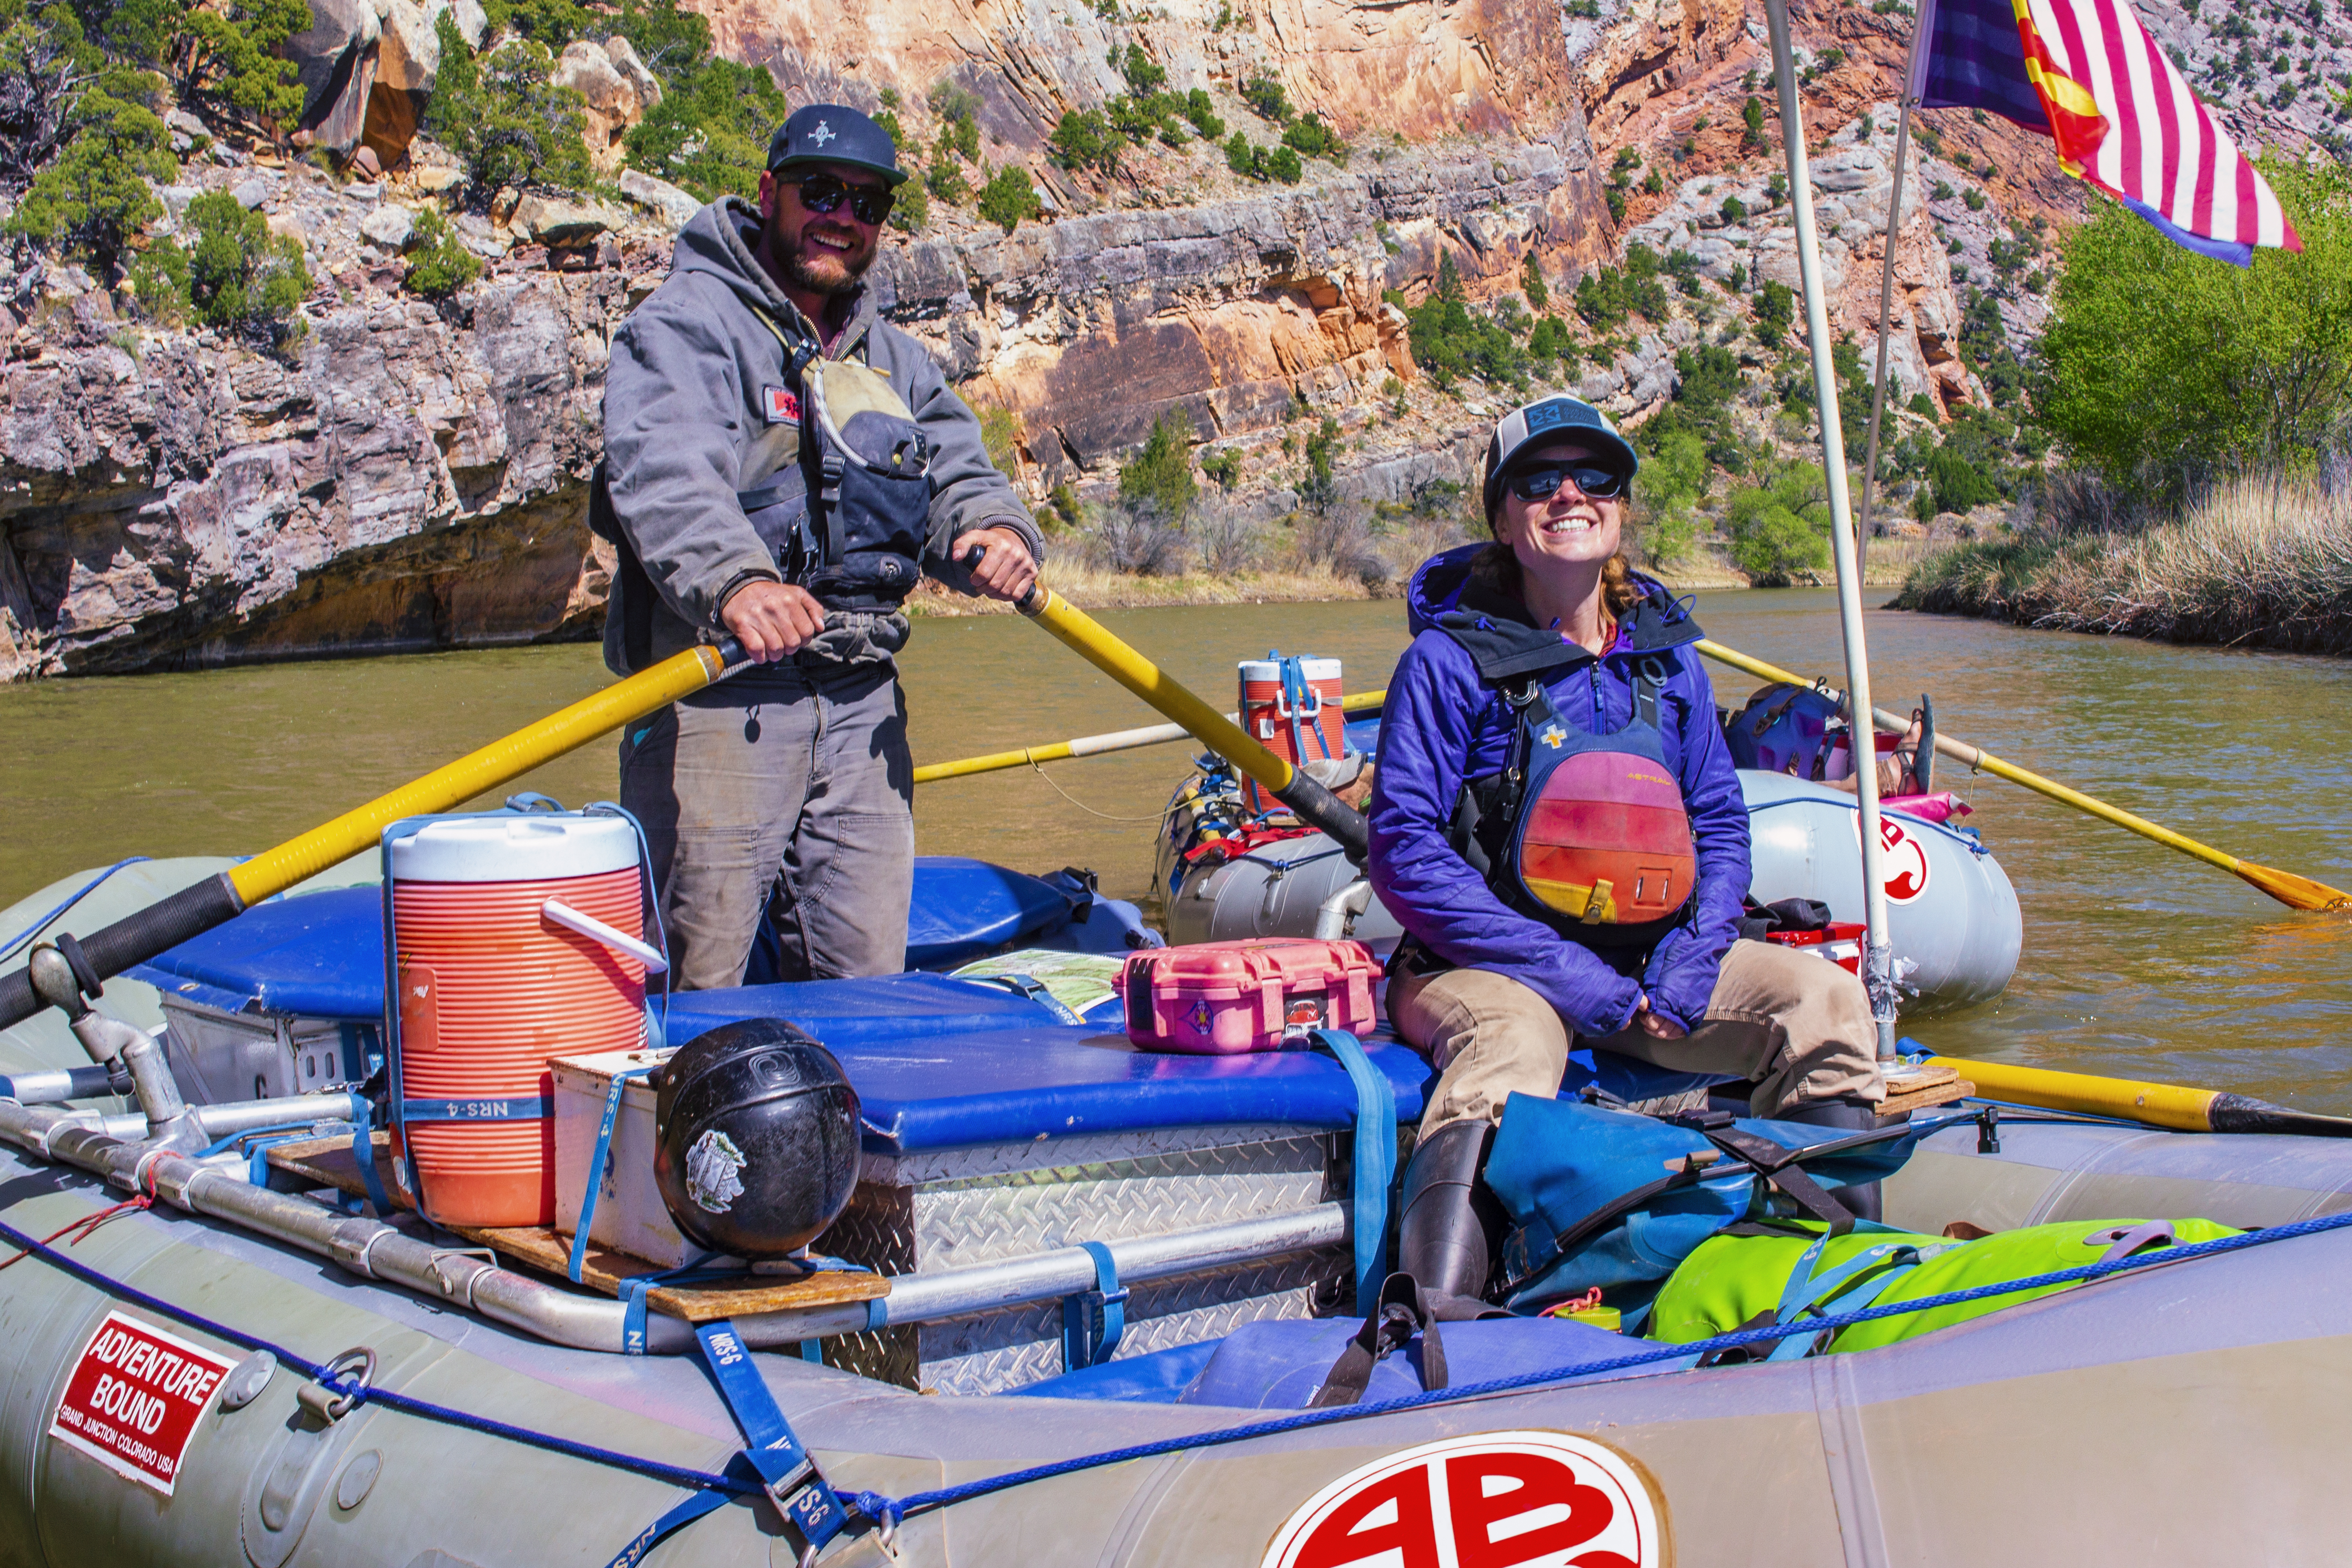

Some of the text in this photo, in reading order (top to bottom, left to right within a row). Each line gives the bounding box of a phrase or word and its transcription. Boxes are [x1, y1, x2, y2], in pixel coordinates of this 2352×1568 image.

[1626, 772, 1671, 786] ASTRAL
[1054, 1005, 1078, 1025] NRS
[446, 1101, 508, 1117] NRS-4
[600, 1073, 627, 1138] NRS-4
[89, 1328, 219, 1406] ADVENTURE
[708, 1332, 743, 1365] NRS-6
[90, 1373, 166, 1435] BOUND
[60, 1404, 174, 1475] GRAND JUNCTION COLORADO USA
[612, 1522, 657, 1568] NRS
